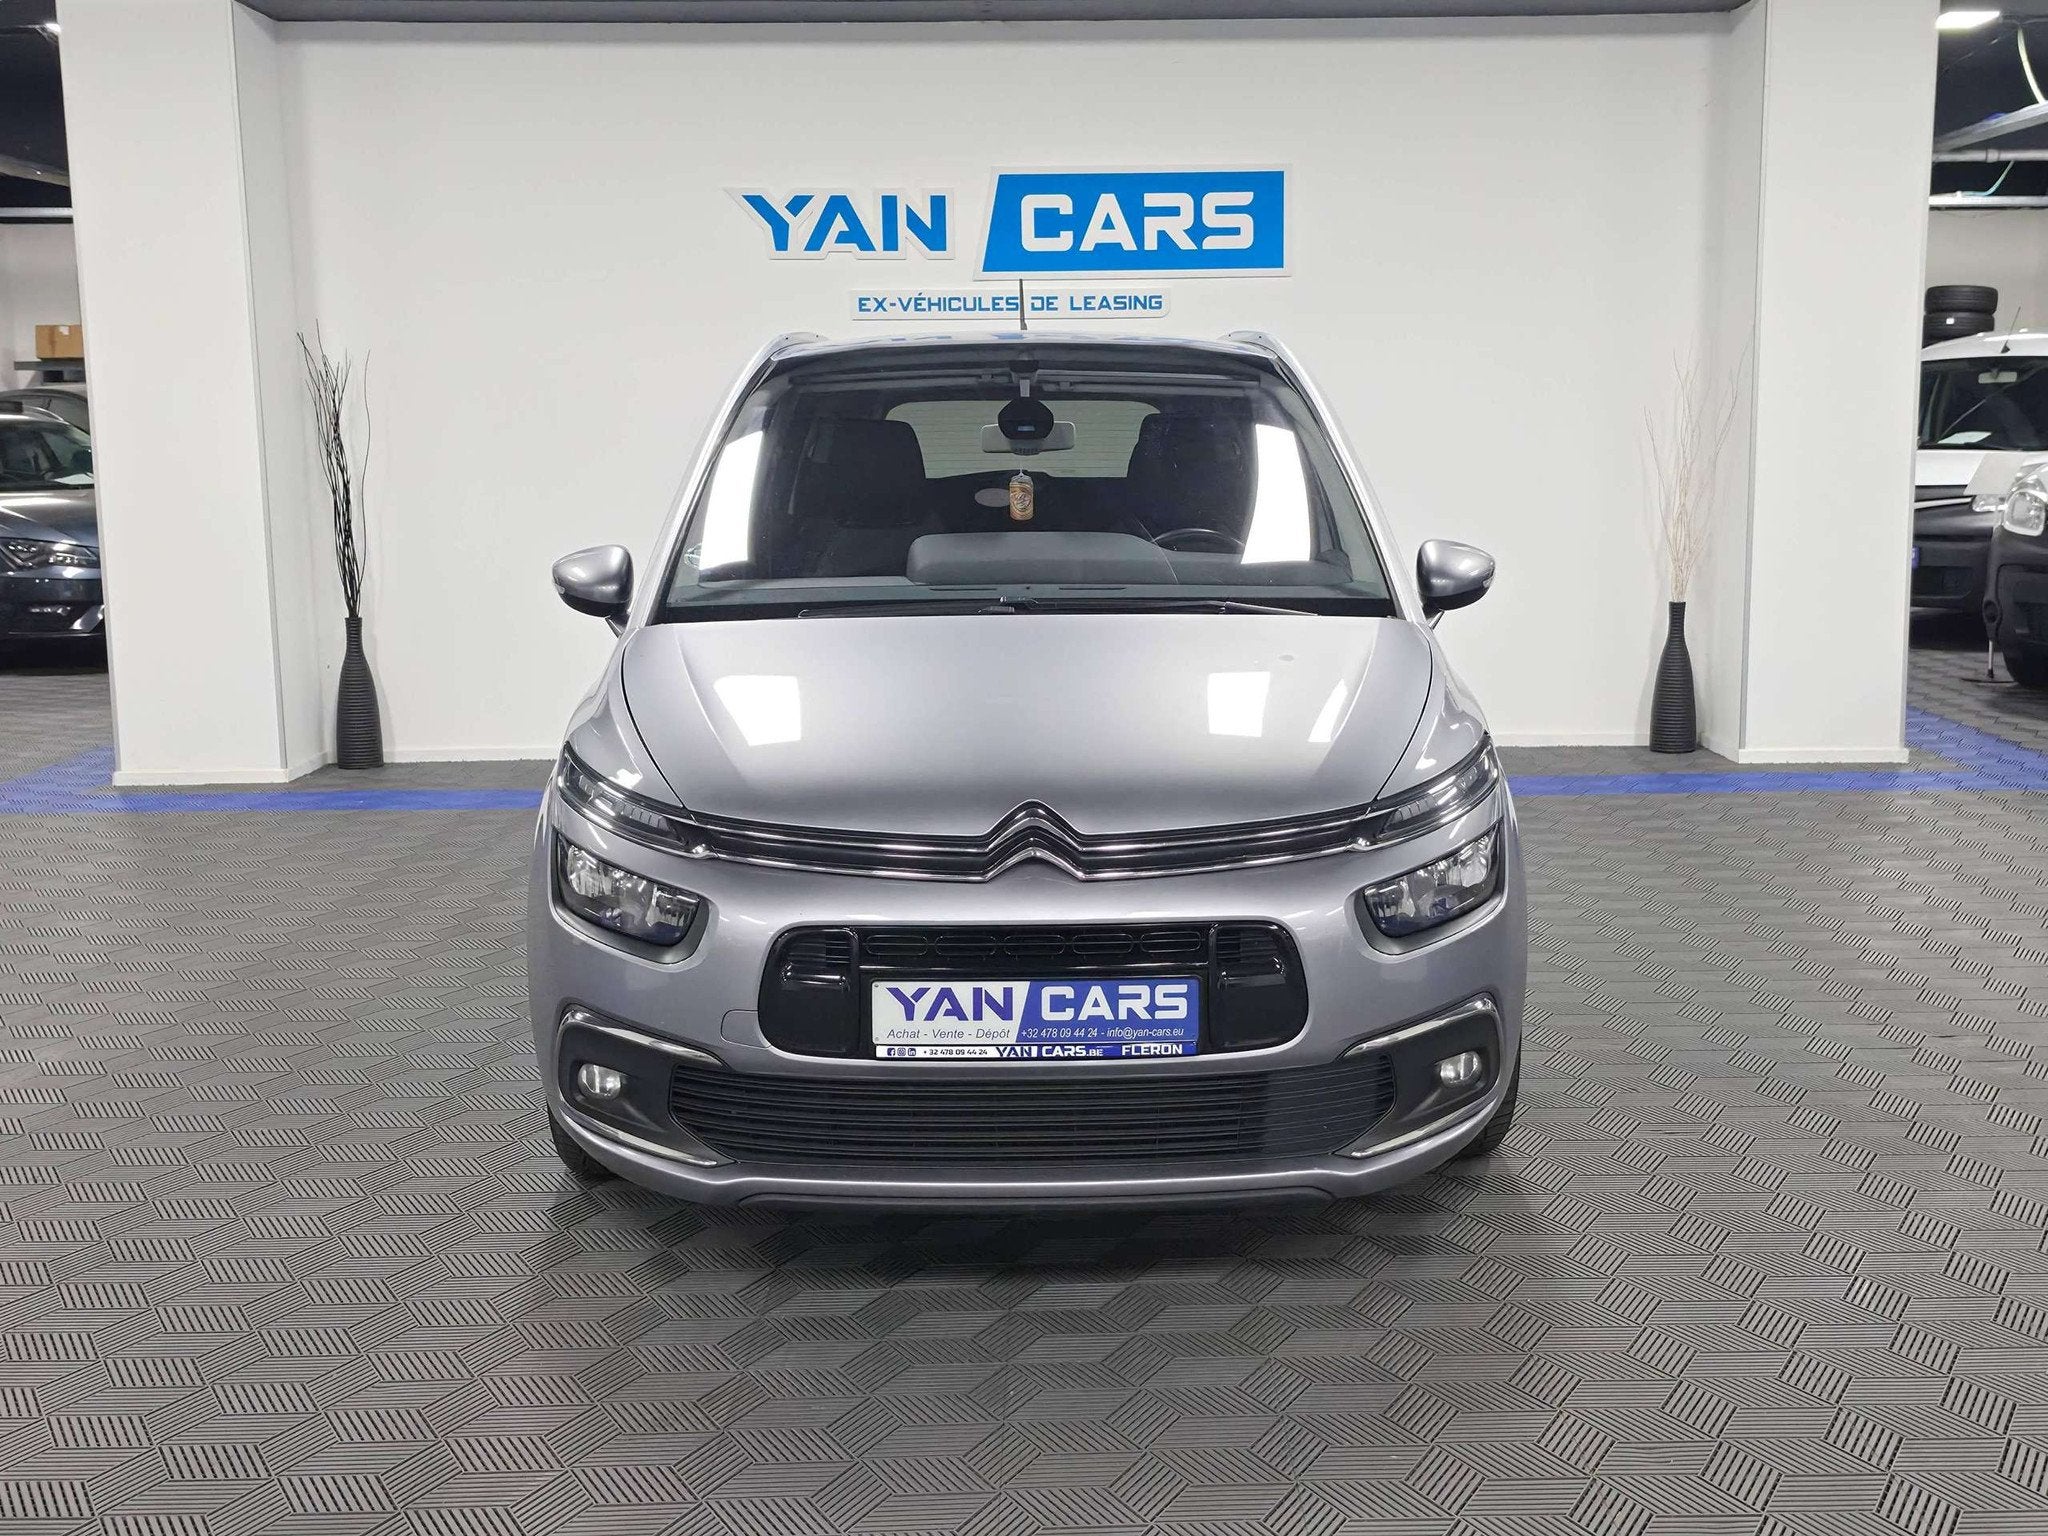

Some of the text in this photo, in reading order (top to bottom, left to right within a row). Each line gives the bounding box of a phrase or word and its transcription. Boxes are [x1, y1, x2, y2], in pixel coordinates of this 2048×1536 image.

[742, 191, 1255, 252] YAN CARS
[858, 292, 1163, 313] EX-VÉHICULES DE LEASING
[886, 984, 1188, 1022] YAN CARS
[887, 1028, 920, 1039] Achat
[932, 1028, 964, 1039] Vente
[976, 1028, 1010, 1042] Dépôt
[1021, 1028, 1038, 1038] +32
[1040, 1028, 1057, 1038] 478
[1059, 1028, 1071, 1038] 09
[1073, 1028, 1085, 1038] 44
[1087, 1027, 1099, 1038] 24
[1106, 1027, 1184, 1040] info@yan-cars.eu
[929, 1048, 939, 1056] 32
[940, 1048, 953, 1056] 478
[955, 1048, 965, 1056] 09
[966, 1048, 977, 1056] 44
[978, 1048, 988, 1056] 24
[996, 1044, 1182, 1057] YAN CARS.BE FLERON
